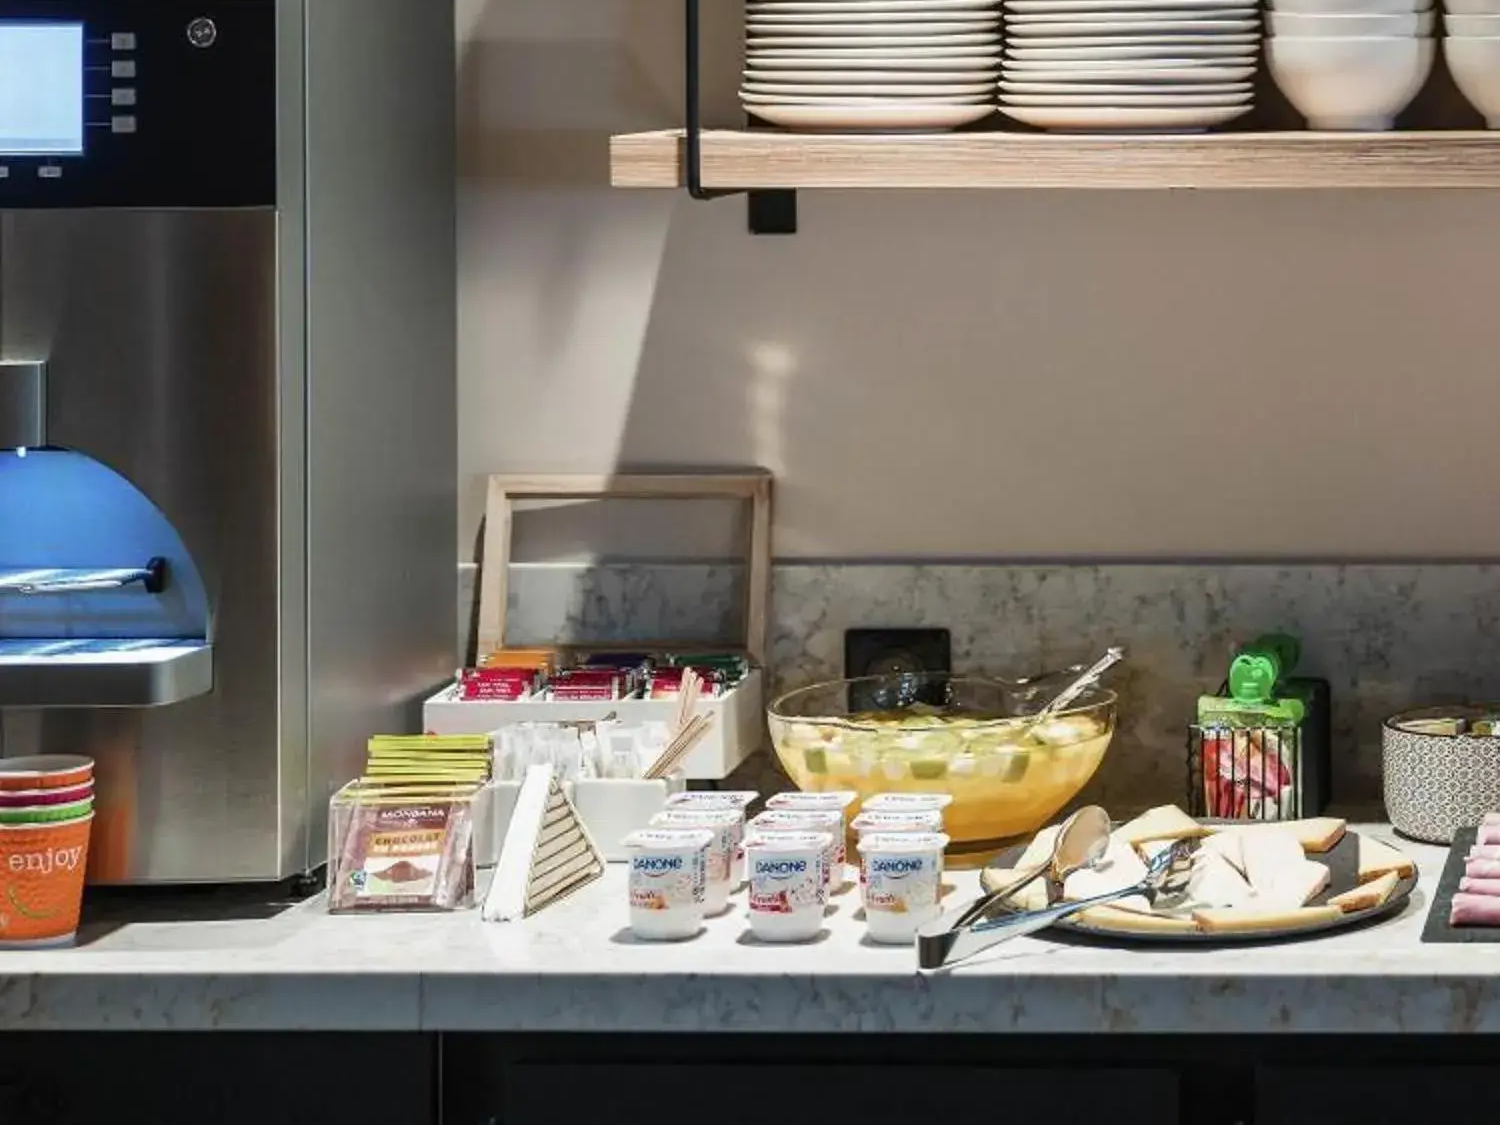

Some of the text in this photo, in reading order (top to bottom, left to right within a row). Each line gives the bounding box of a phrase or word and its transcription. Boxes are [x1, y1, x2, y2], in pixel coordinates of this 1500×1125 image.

[8, 845, 83, 874] enjoy
[633, 855, 683, 871] DANONE
[755, 859, 808, 874] DANONE
[872, 858, 924, 873] DANONE
